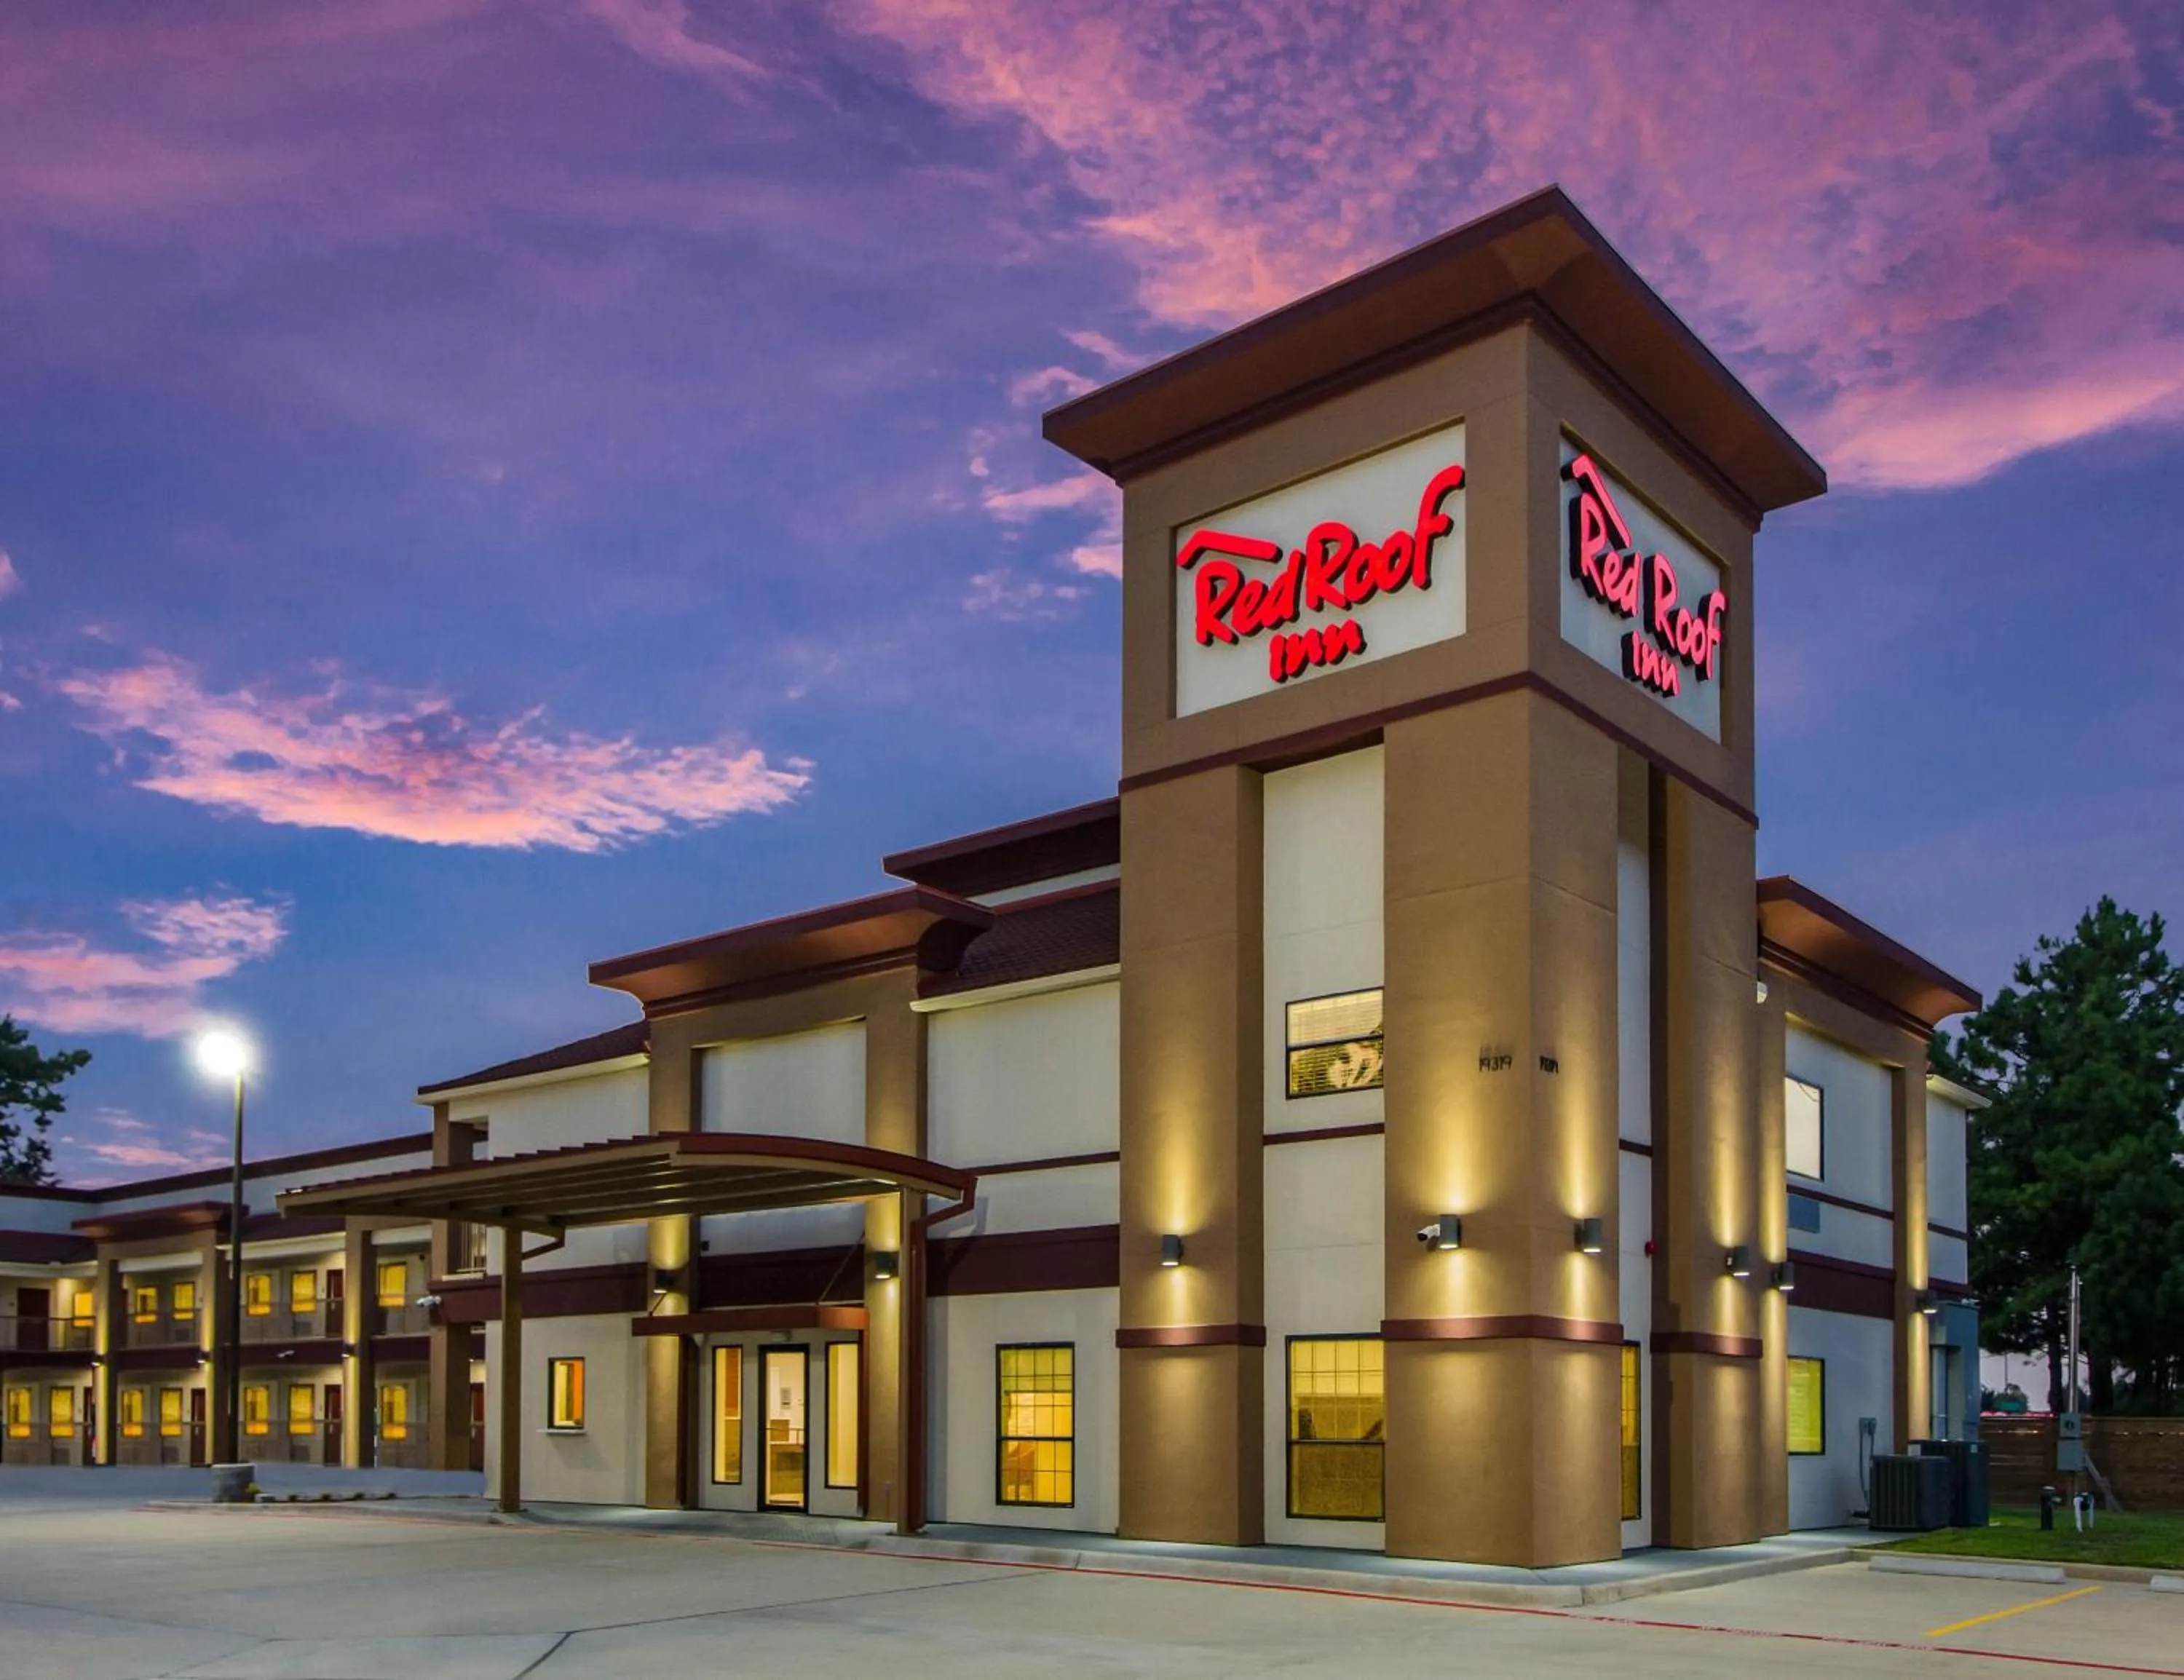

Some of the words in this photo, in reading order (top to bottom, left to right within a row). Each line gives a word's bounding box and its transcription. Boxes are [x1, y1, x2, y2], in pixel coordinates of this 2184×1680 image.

[1195, 550, 1305, 643] Red
[1306, 464, 1465, 610] Roof
[1580, 492, 1641, 617] Red
[1654, 552, 1726, 680] Roof
[1270, 619, 1366, 683] Inn
[1632, 630, 1680, 696] Inn
